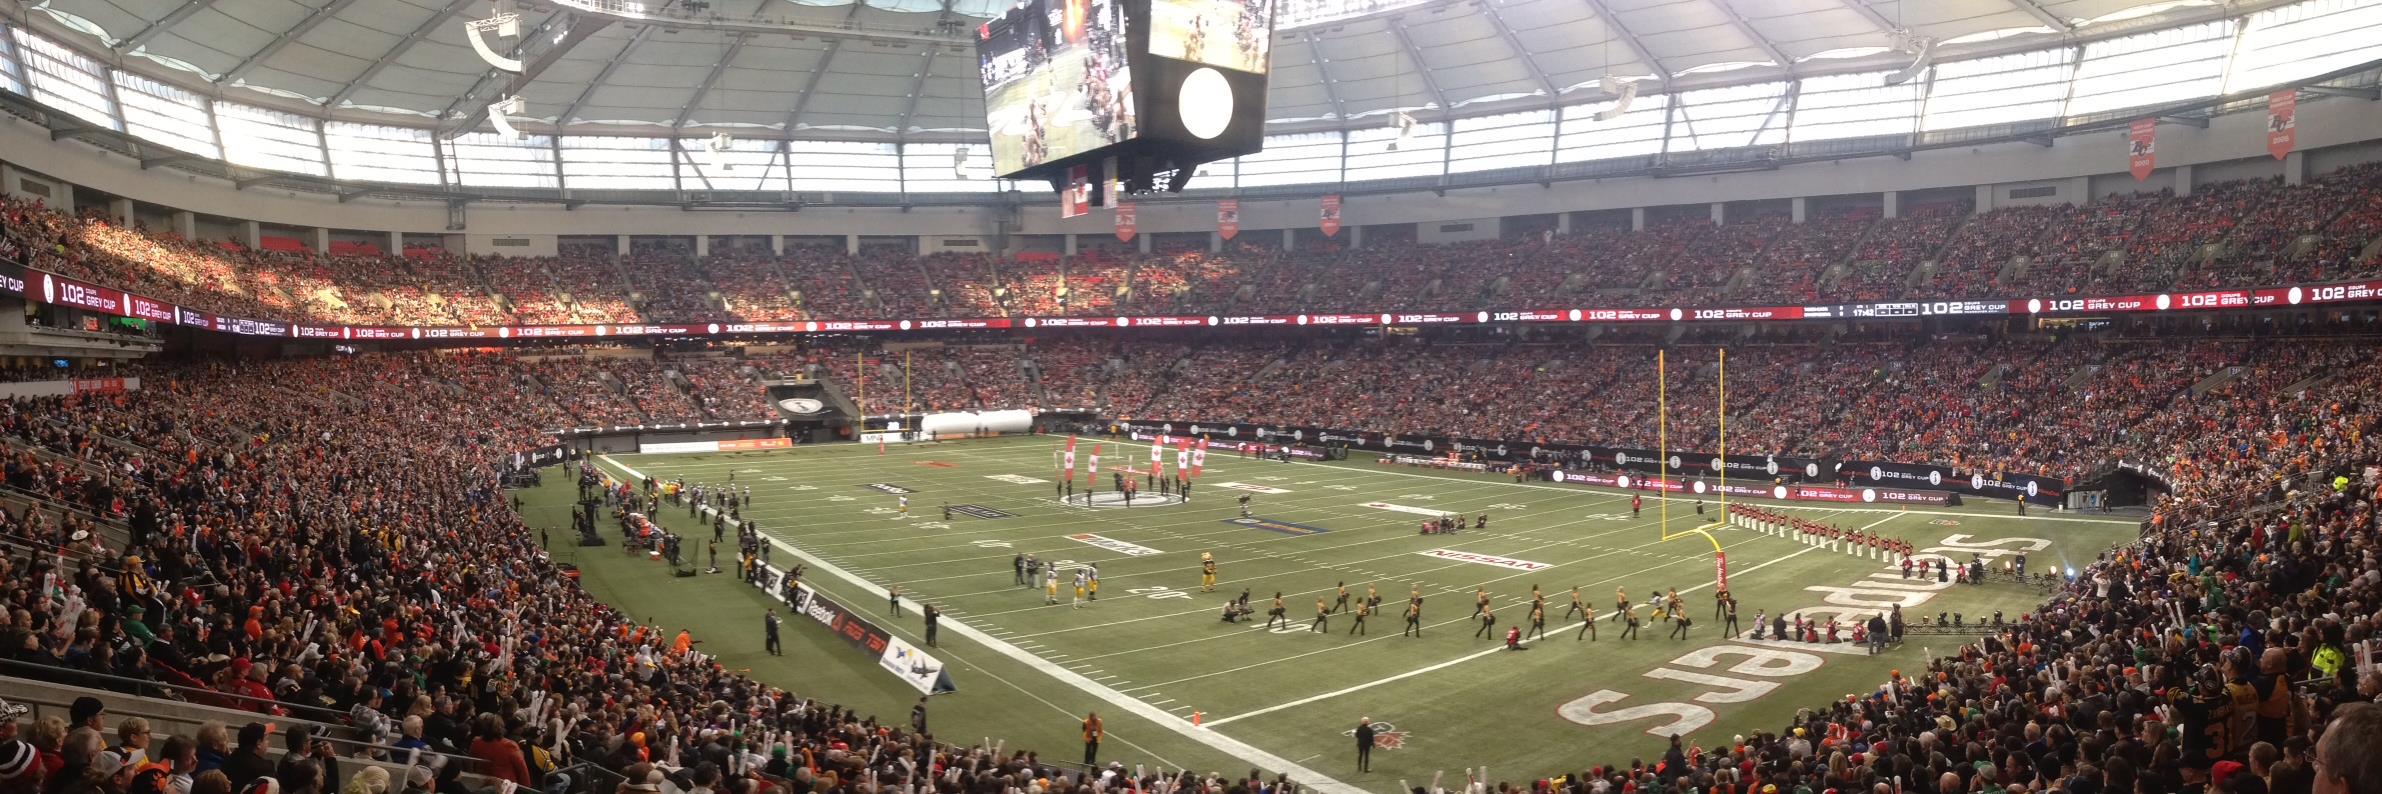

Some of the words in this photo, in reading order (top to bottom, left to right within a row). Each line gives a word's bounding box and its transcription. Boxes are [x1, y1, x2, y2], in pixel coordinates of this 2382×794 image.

[8, 278, 24, 292] CUP
[61, 283, 85, 305] 102
[86, 296, 102, 308] GREY
[103, 299, 116, 310] CUP
[2312, 287, 2345, 300] 102
[2348, 288, 2375, 299] GREY
[2049, 299, 2084, 311] 102
[2088, 302, 2115, 310] GREY
[2117, 301, 2141, 309] CUP
[2181, 294, 2217, 307] 102
[2221, 296, 2249, 305] GREY
[135, 300, 151, 316] 102
[151, 309, 162, 319] GREY
[163, 311, 171, 320] CUP
[1922, 302, 1963, 315] 102
[184, 311, 195, 324] 102
[1399, 315, 1423, 323] 102
[1494, 312, 1518, 321] 102
[1590, 311, 1617, 320] 102
[1694, 310, 1725, 319] 102
[1136, 318, 1162, 326] 102
[1224, 317, 1249, 325] 102
[1313, 316, 1338, 324] 102
[255, 322, 270, 335] 102
[300, 327, 314, 337] 102
[517, 328, 542, 336] 102
[615, 326, 643, 335] 102
[726, 324, 754, 332] 102
[355, 329, 374, 338] 102
[425, 329, 448, 337] 102
[1566, 473, 1586, 481] 102
[1882, 471, 1899, 479] 102
[1712, 484, 1733, 492] 102
[1882, 492, 1906, 500] 102
[1431, 550, 1546, 570] NISSAN
[807, 599, 836, 626] Reebok
